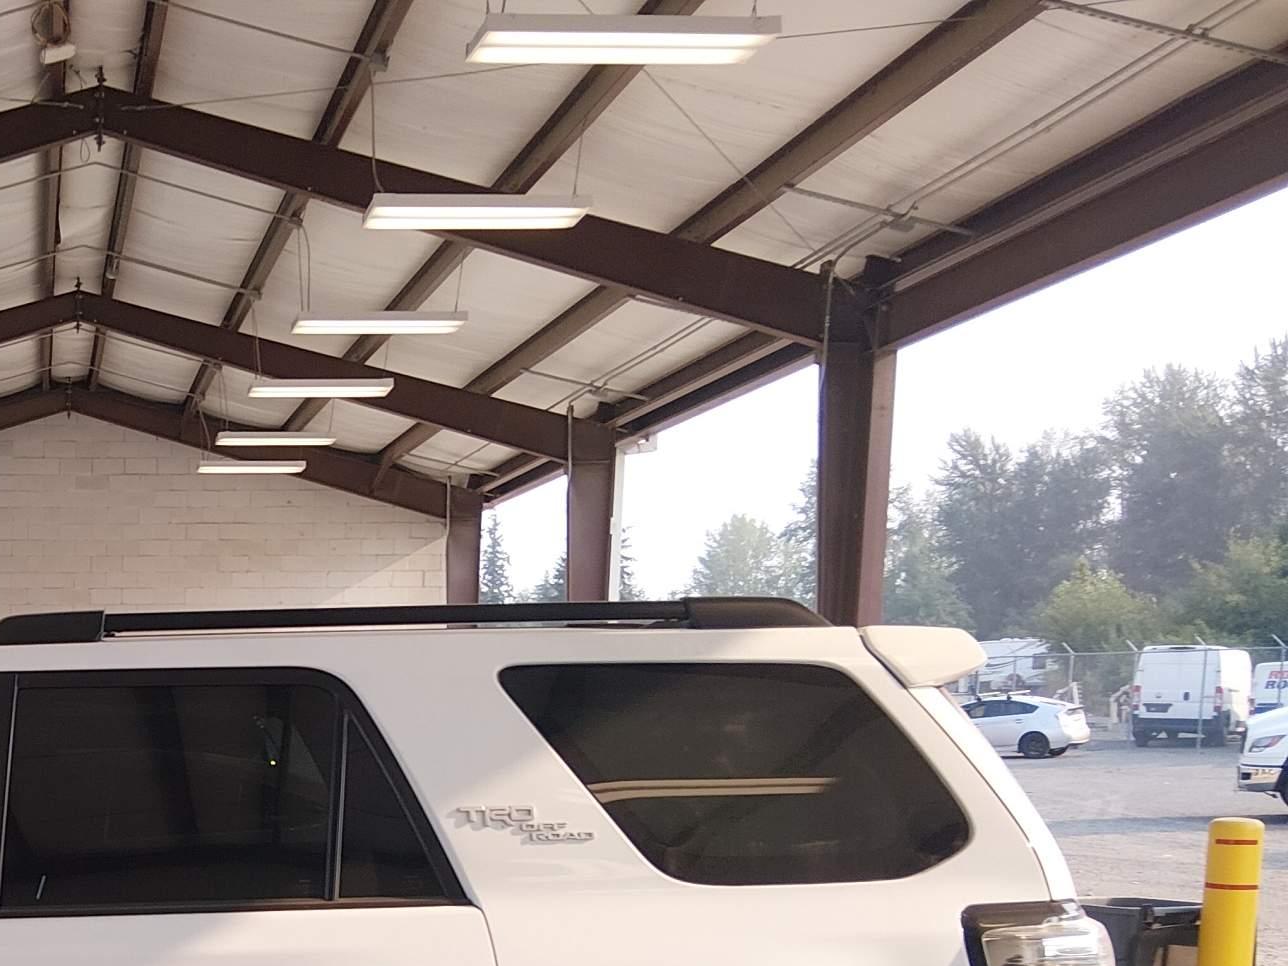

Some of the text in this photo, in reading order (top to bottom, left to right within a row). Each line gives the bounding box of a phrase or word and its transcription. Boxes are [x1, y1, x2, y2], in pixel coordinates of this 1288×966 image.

[456, 805, 535, 827] TRD
[519, 822, 567, 832] OFF
[528, 831, 594, 842] ROAD
